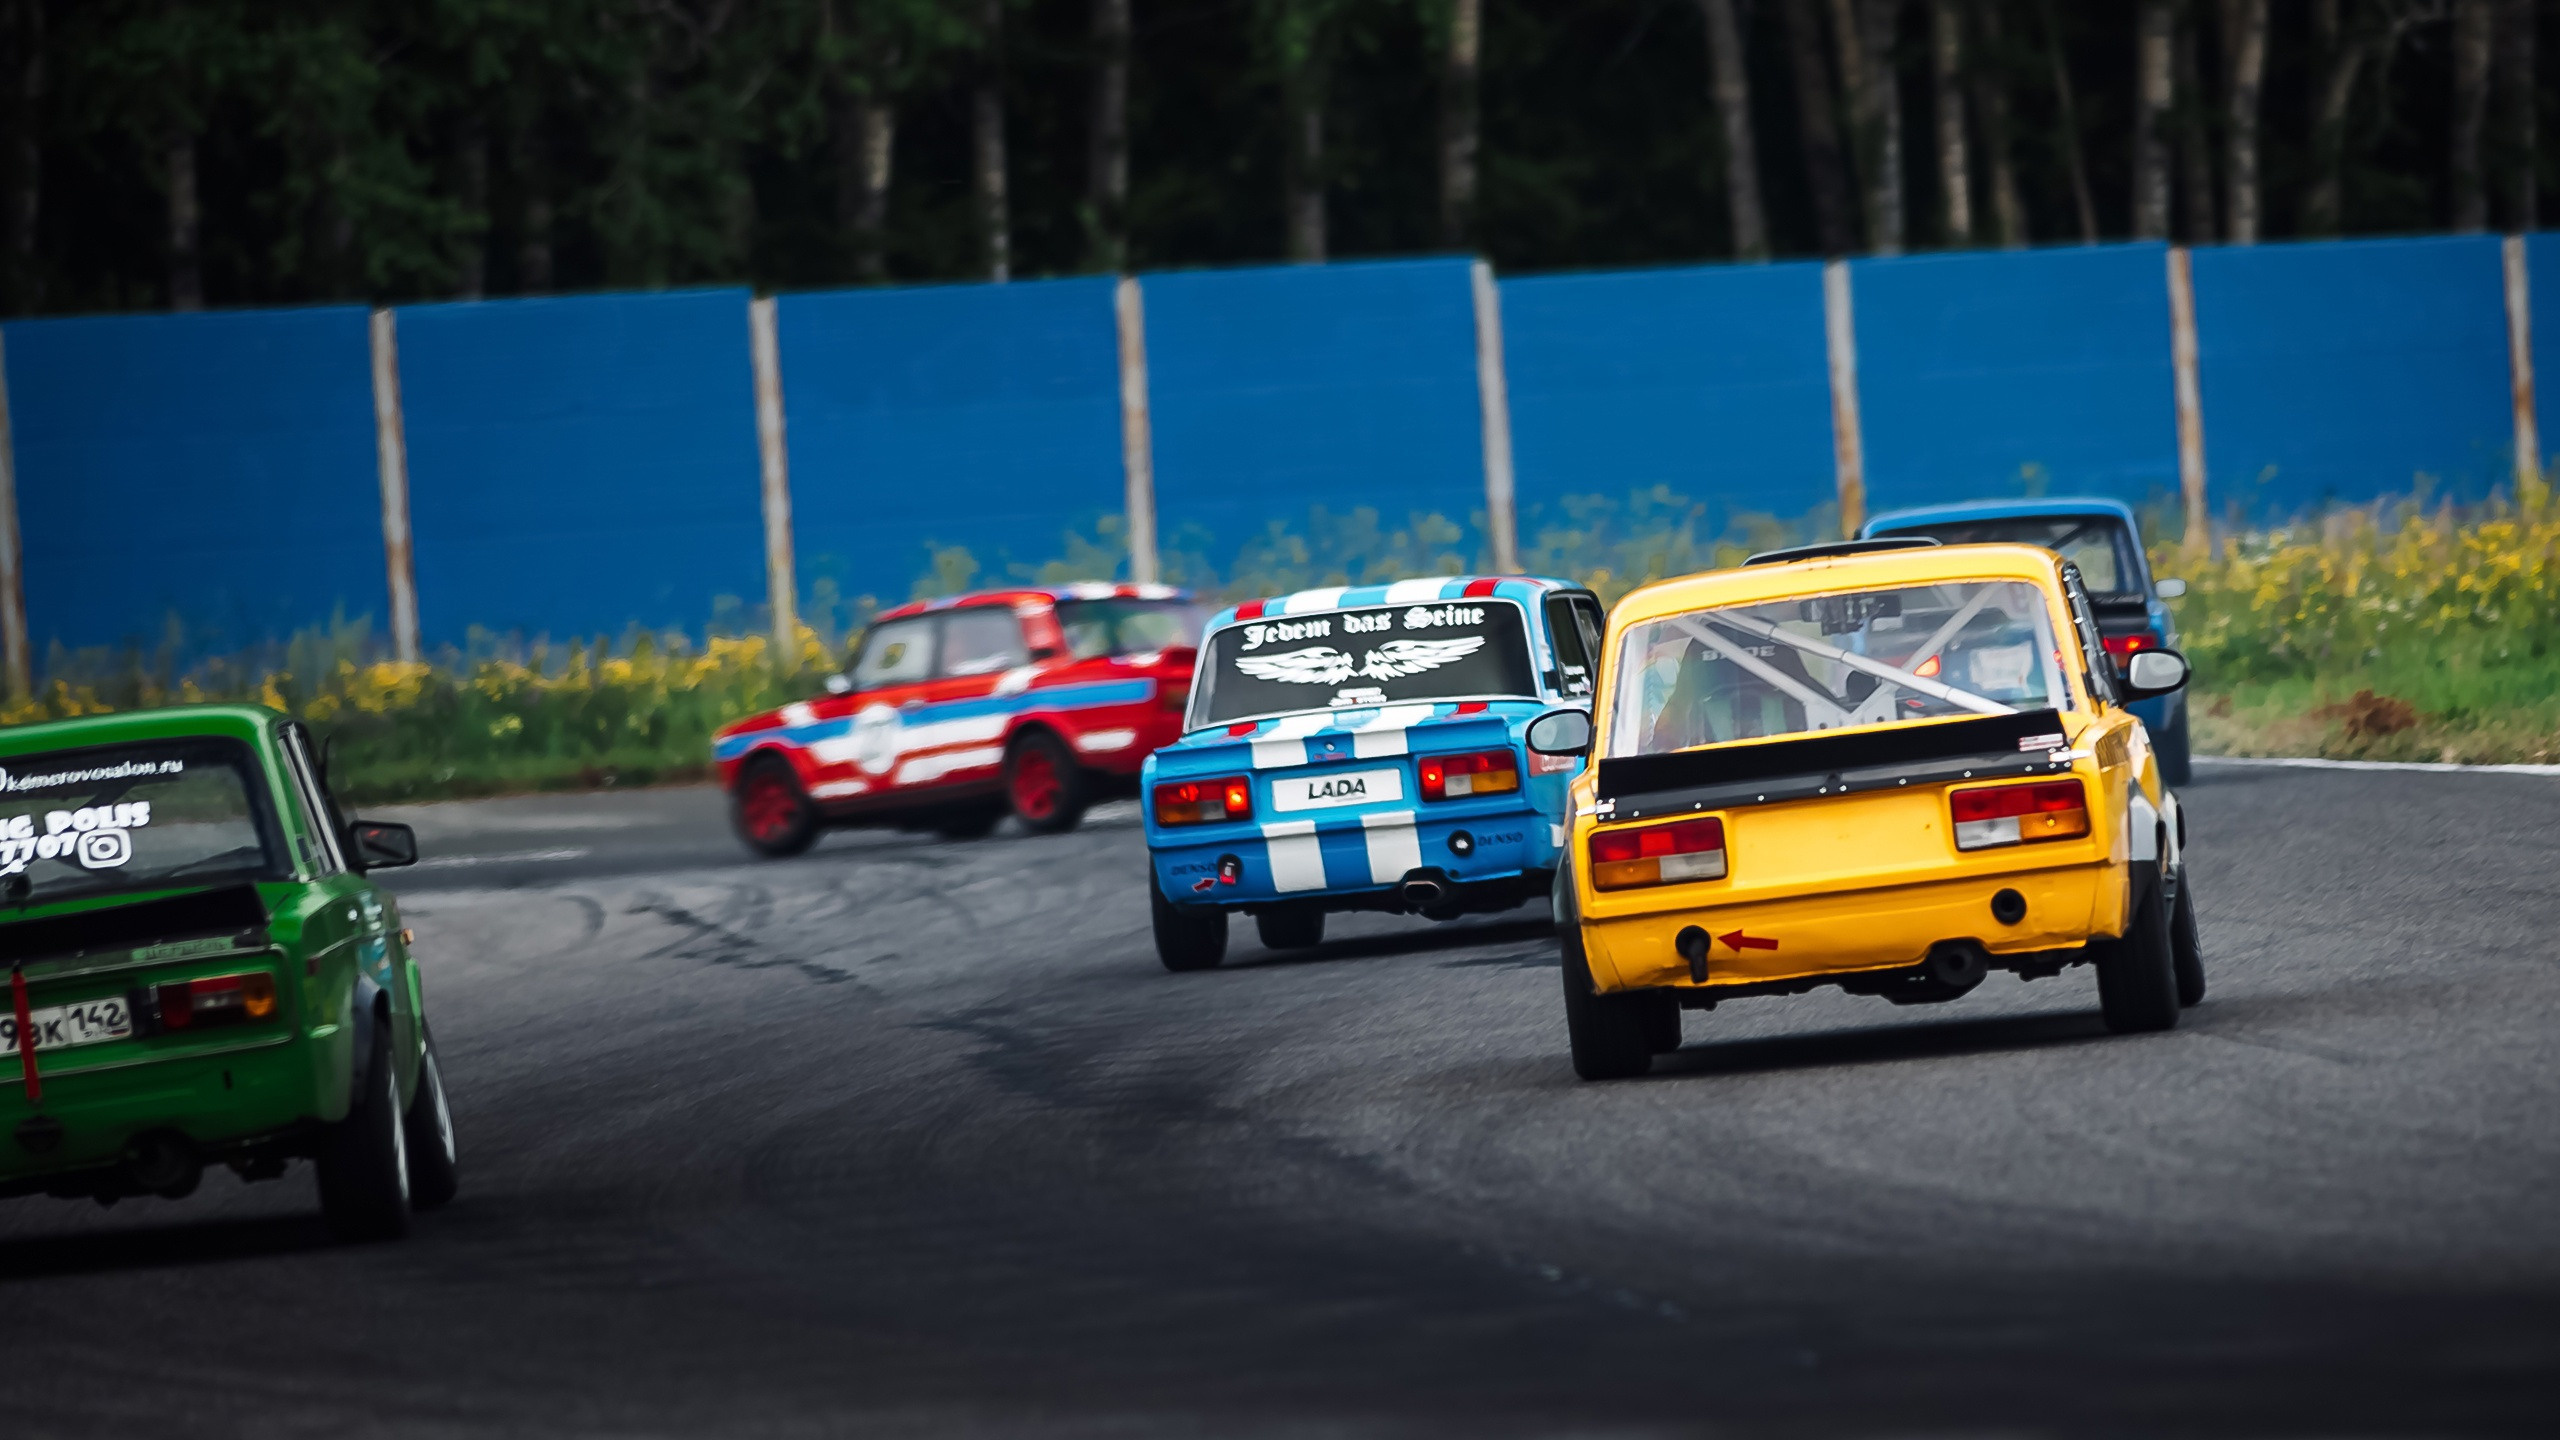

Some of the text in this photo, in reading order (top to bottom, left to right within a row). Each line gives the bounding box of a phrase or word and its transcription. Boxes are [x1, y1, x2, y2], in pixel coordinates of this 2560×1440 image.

[1241, 605, 1484, 651] Jedem das Seine
[1308, 778, 1366, 799] LADA
[46, 801, 150, 835] POLIS
[71, 1003, 126, 1031] 142
